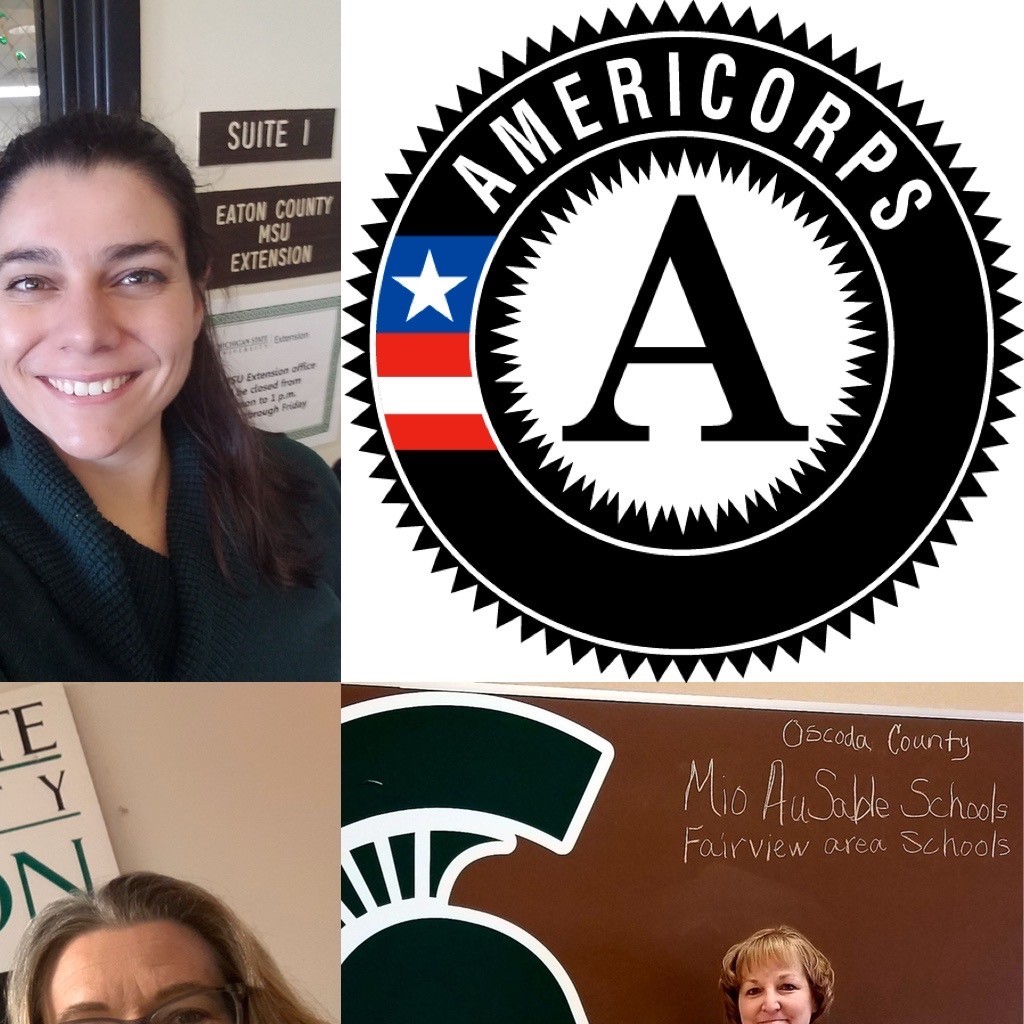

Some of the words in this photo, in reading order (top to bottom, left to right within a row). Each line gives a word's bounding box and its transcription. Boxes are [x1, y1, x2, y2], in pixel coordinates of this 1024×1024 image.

[227, 119, 290, 150] SUITE
[451, 51, 933, 232] AMERICORPS
[216, 201, 268, 226] EATON
[275, 195, 335, 220] COUNTY
[258, 222, 292, 244] MSU
[230, 244, 314, 273] EXTENSION
[561, 193, 809, 443] A
[274, 332, 309, 344] Extension
[247, 366, 290, 382] Extension
[291, 361, 316, 374] office
[250, 380, 278, 394] closed
[281, 377, 302, 387] from
[259, 396, 268, 404] to
[278, 390, 296, 403] p.m.
[281, 399, 307, 412] Friday
[782, 719, 872, 752] Oscoda
[888, 723, 971, 761] County
[684, 758, 748, 817] Mio
[762, 759, 890, 826] AuSable
[900, 778, 1008, 824] Schools
[683, 824, 811, 864] Fairview
[824, 835, 887, 855] area
[900, 829, 1011, 859] Schools
